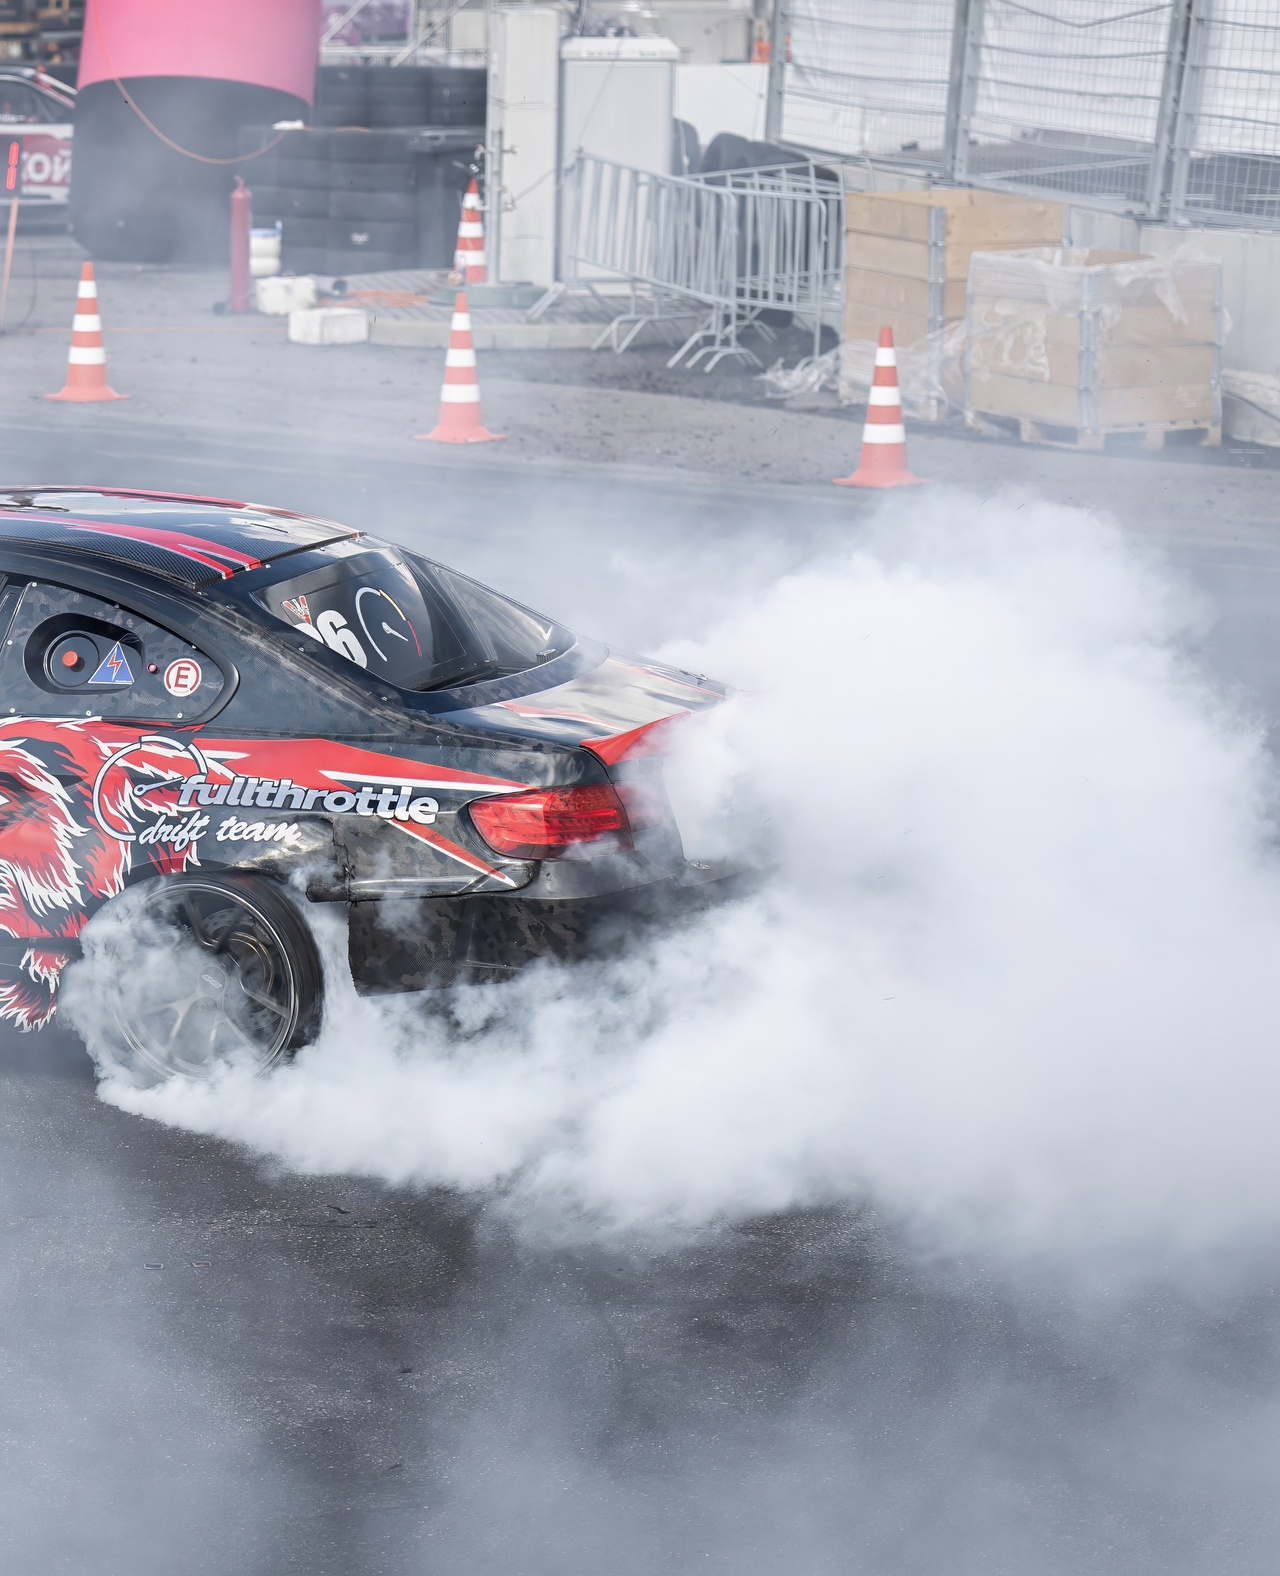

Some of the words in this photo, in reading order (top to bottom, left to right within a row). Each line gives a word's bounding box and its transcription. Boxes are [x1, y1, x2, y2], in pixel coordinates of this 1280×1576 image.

[174, 666, 191, 689] E
[178, 774, 440, 824] fullthrottle
[138, 809, 211, 852] drift
[216, 815, 302, 844] team
